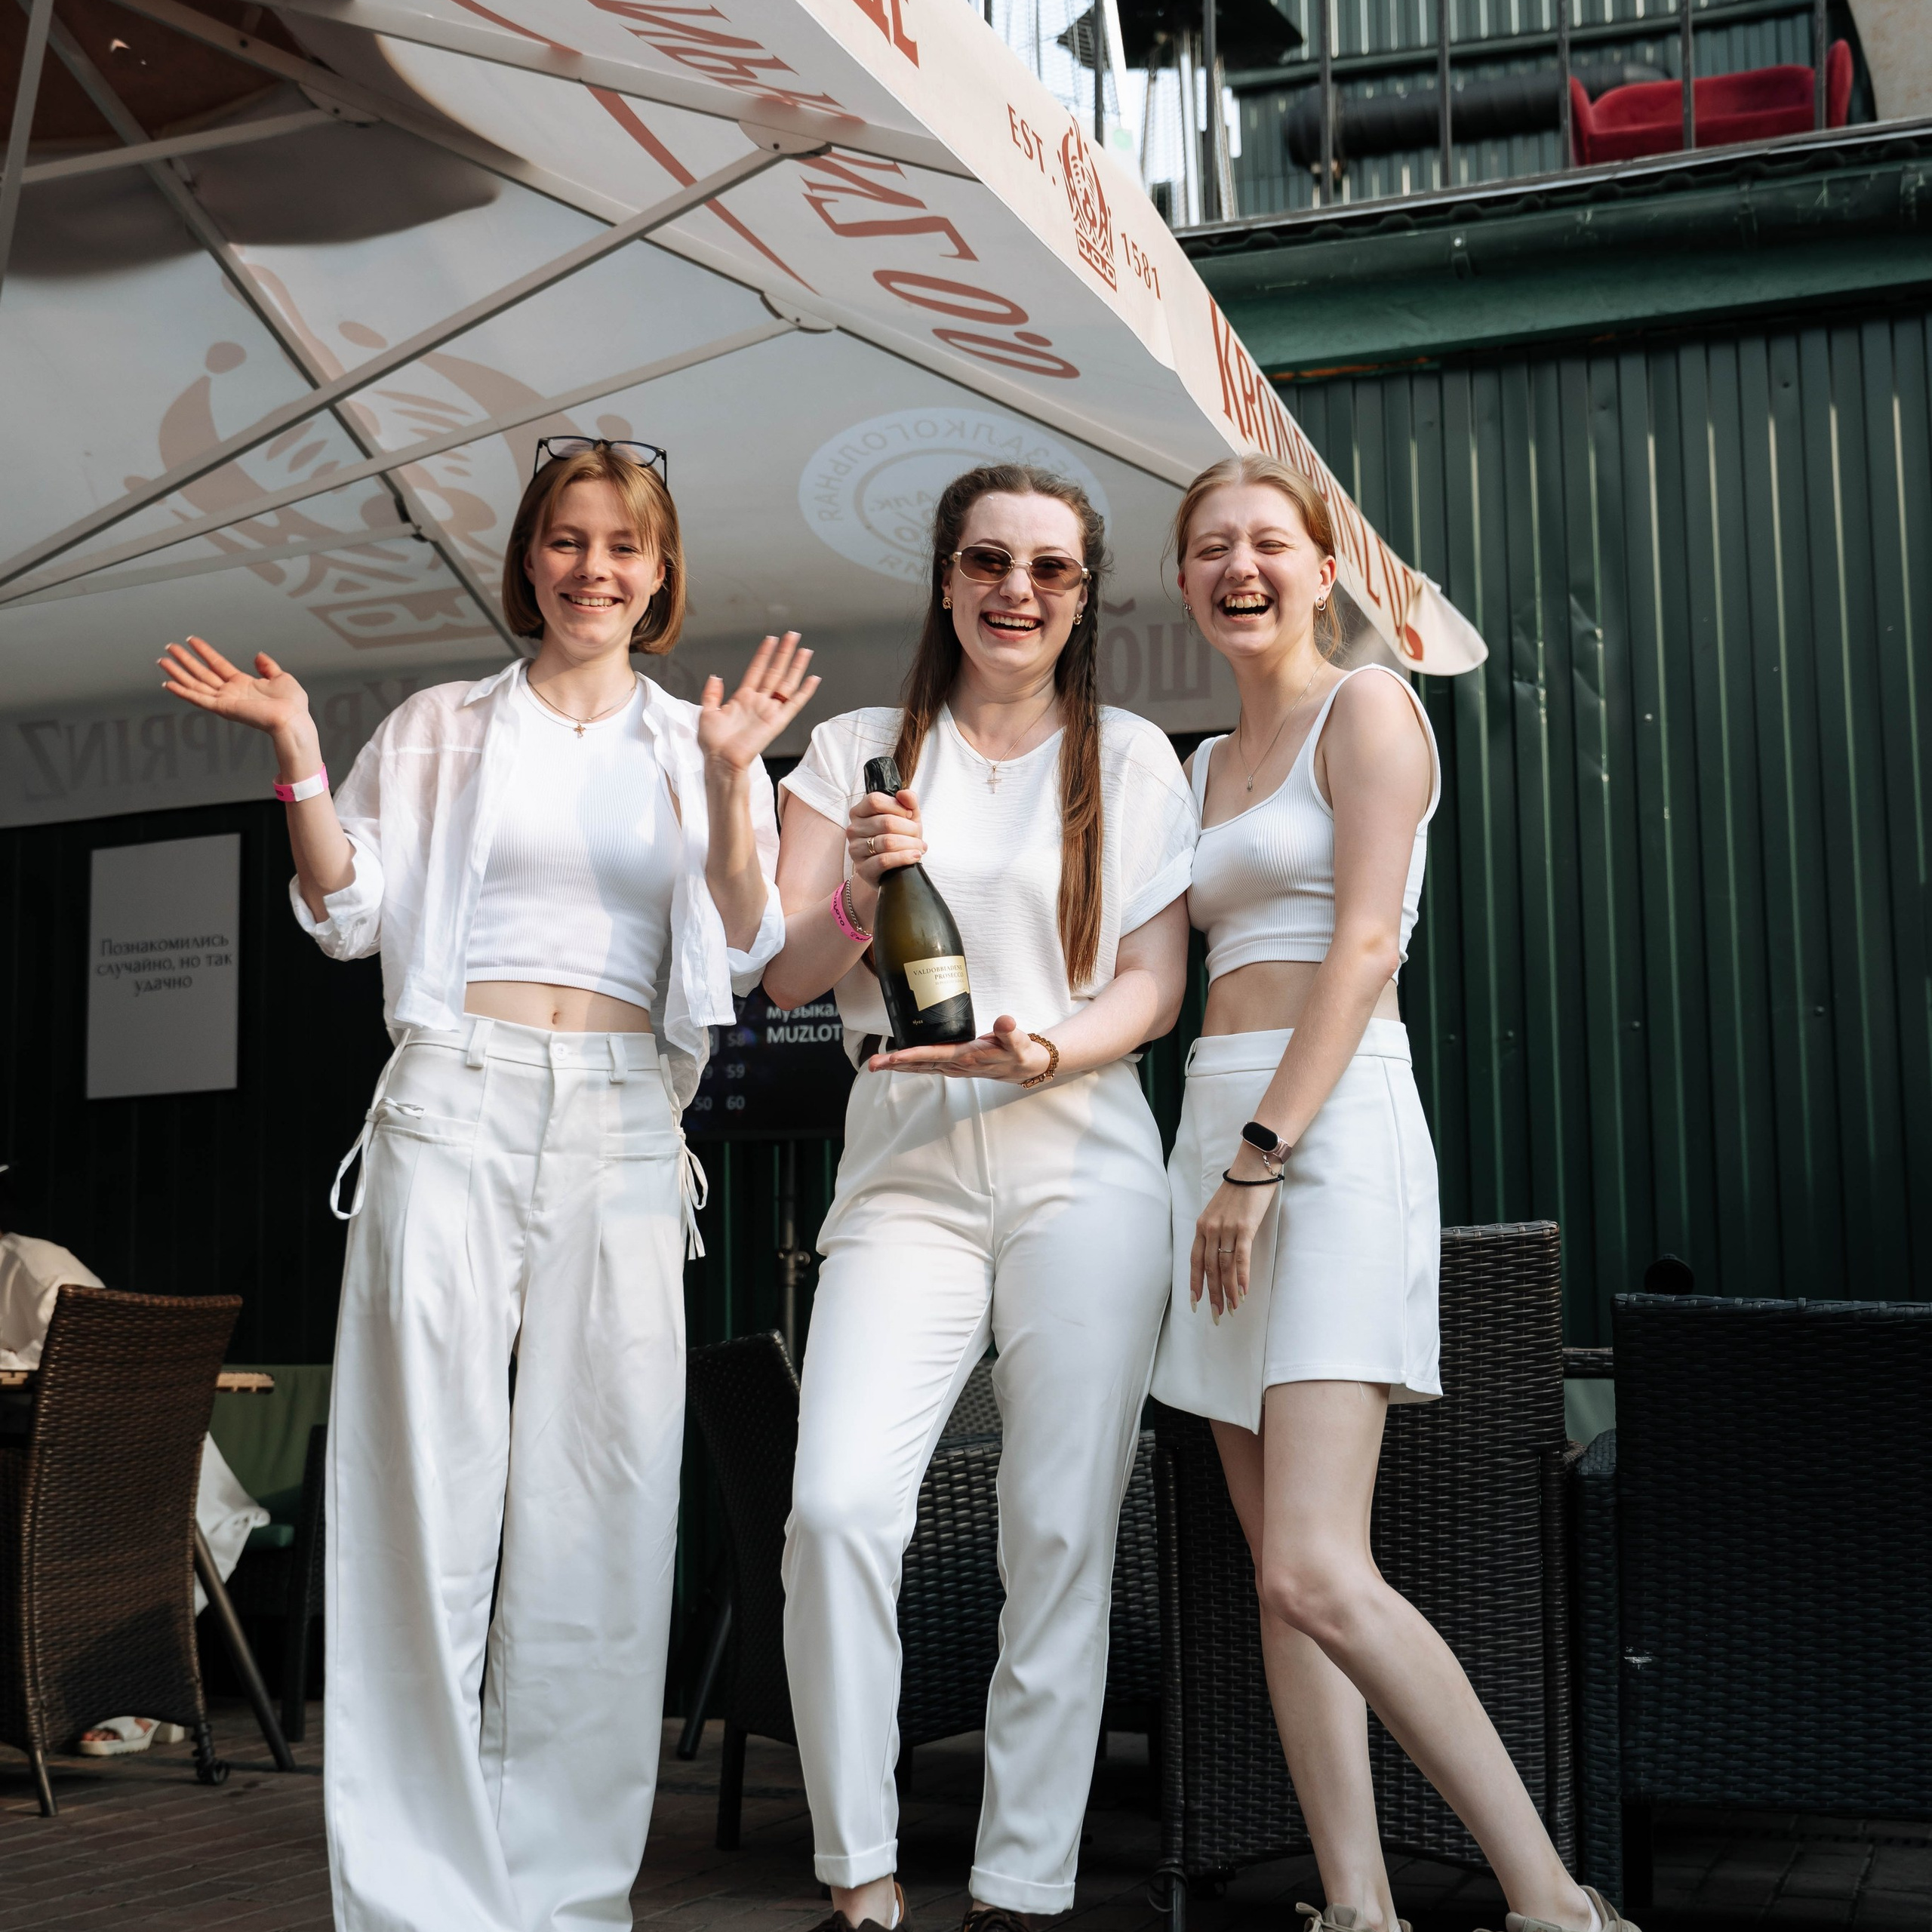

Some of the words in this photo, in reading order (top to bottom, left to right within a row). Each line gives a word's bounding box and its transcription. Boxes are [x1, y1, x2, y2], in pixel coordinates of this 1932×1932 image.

[1121, 232, 1161, 301] 1581
[100, 934, 230, 956] Познакомились
[180, 955, 202, 970] но
[205, 953, 232, 968] так
[934, 971, 964, 980] PROSECCO
[132, 975, 193, 998] удачно
[766, 1023, 844, 1044] MUZLOT
[726, 1063, 746, 1079] 59
[694, 1095, 713, 1112] 50
[725, 1094, 746, 1111] 60
